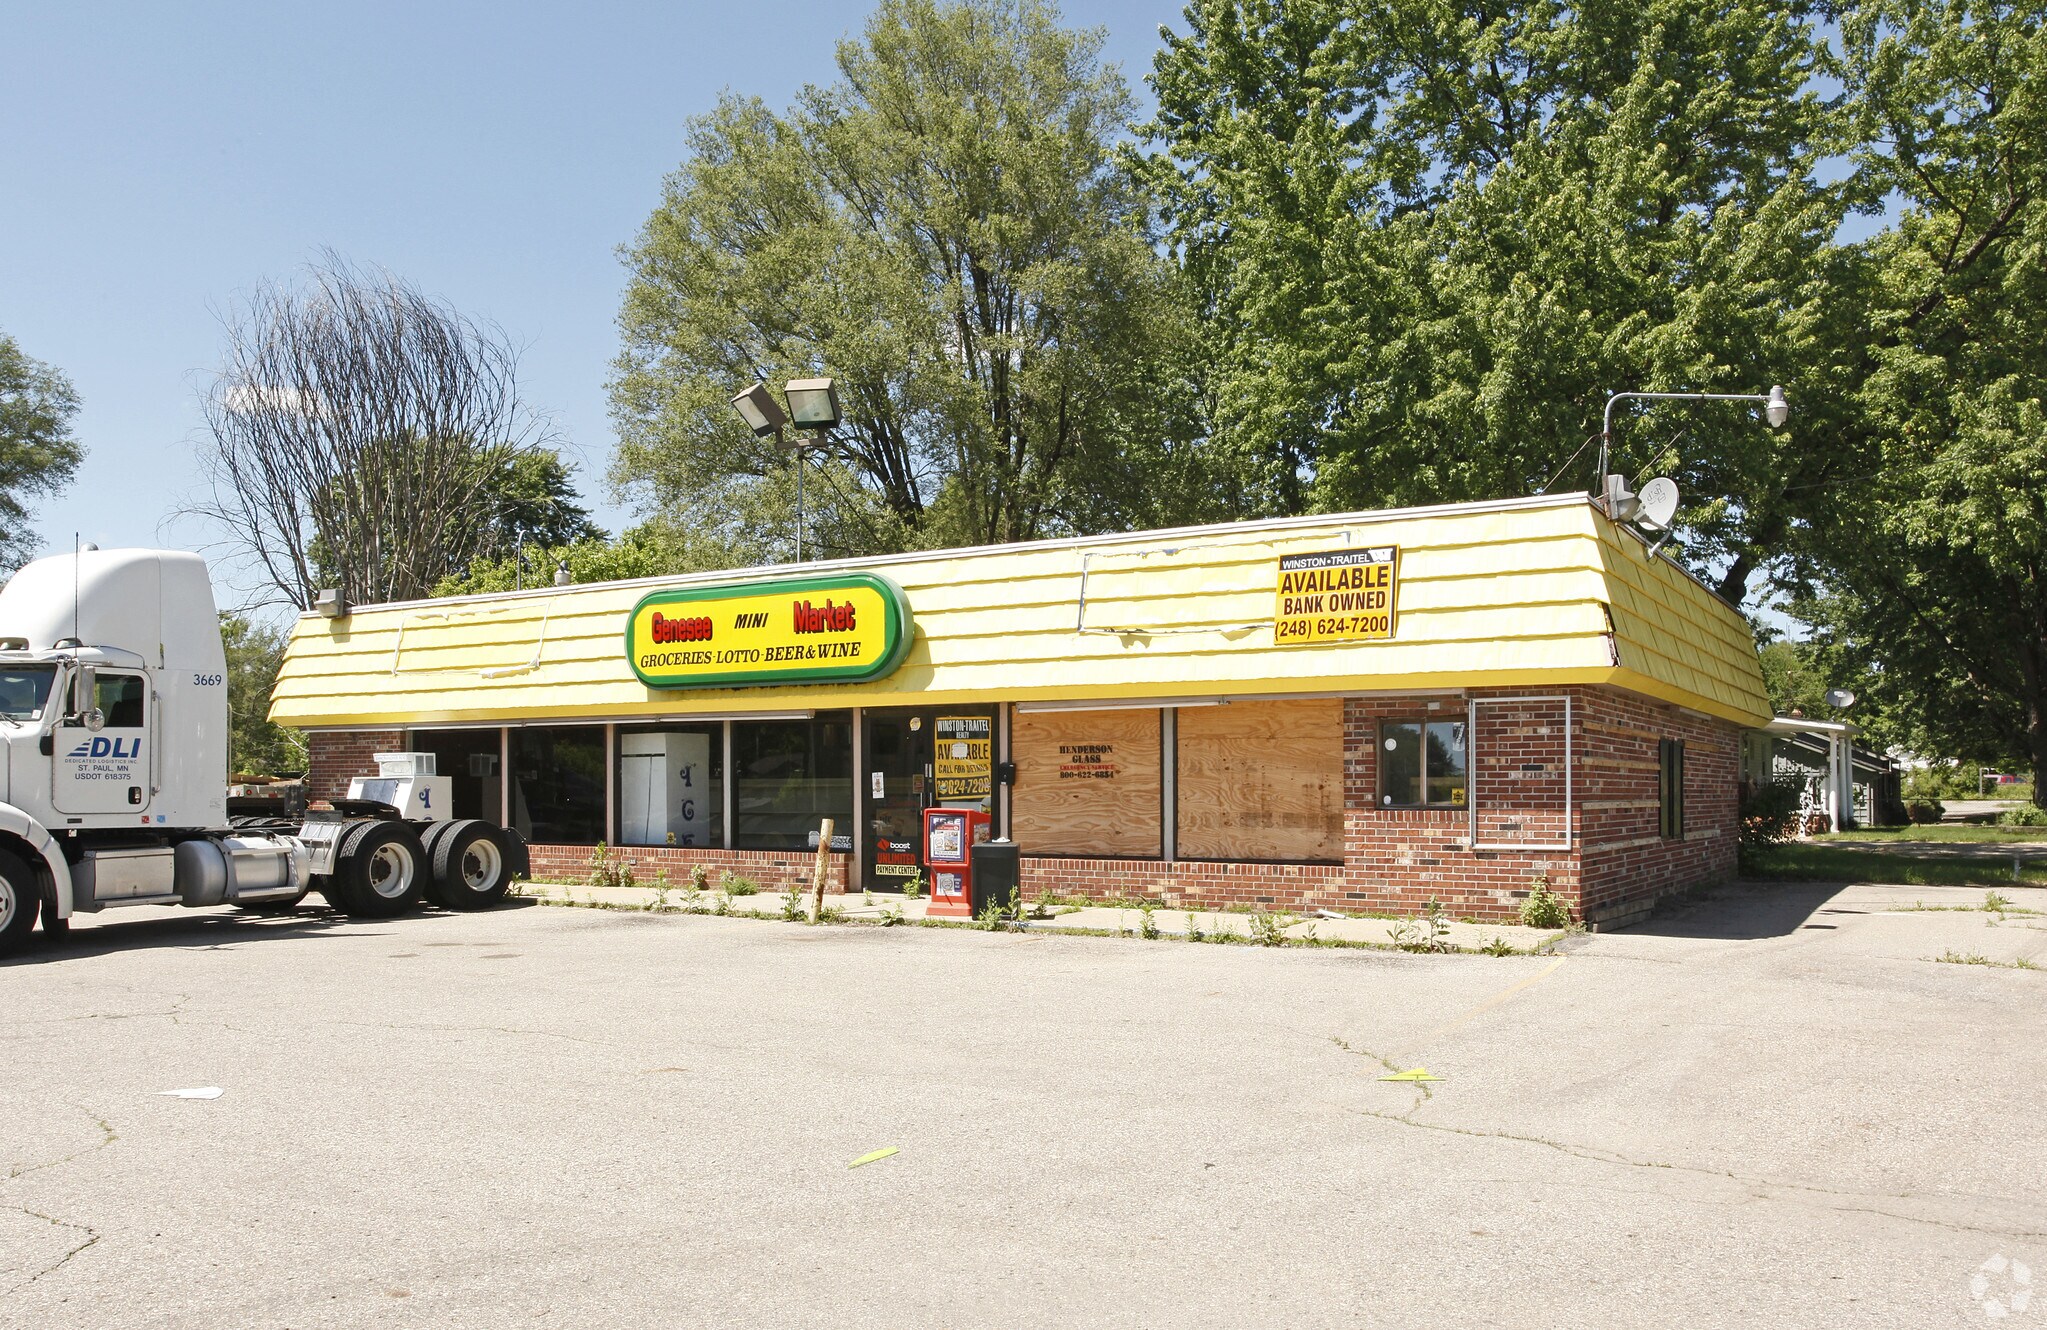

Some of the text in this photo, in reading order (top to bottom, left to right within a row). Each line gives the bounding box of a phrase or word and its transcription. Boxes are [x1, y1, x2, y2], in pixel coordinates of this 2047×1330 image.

[1280, 566, 1389, 594] AVAILABLE
[1283, 591, 1386, 615] BANK OWNED
[651, 598, 856, 644] Genesee MINI Market
[1275, 616, 1388, 641] (248) 624-7200
[193, 674, 222, 686] 3669
[90, 737, 141, 758] DLI
[938, 743, 989, 760] AVABLE
[1059, 745, 1113, 754] HENDERSON
[1072, 754, 1101, 763] GLASS
[938, 764, 953, 773] CALL
[954, 764, 965, 773] FOR
[877, 853, 916, 864] UNLIMITED
[877, 865, 916, 875] PAYMENT CENTER
